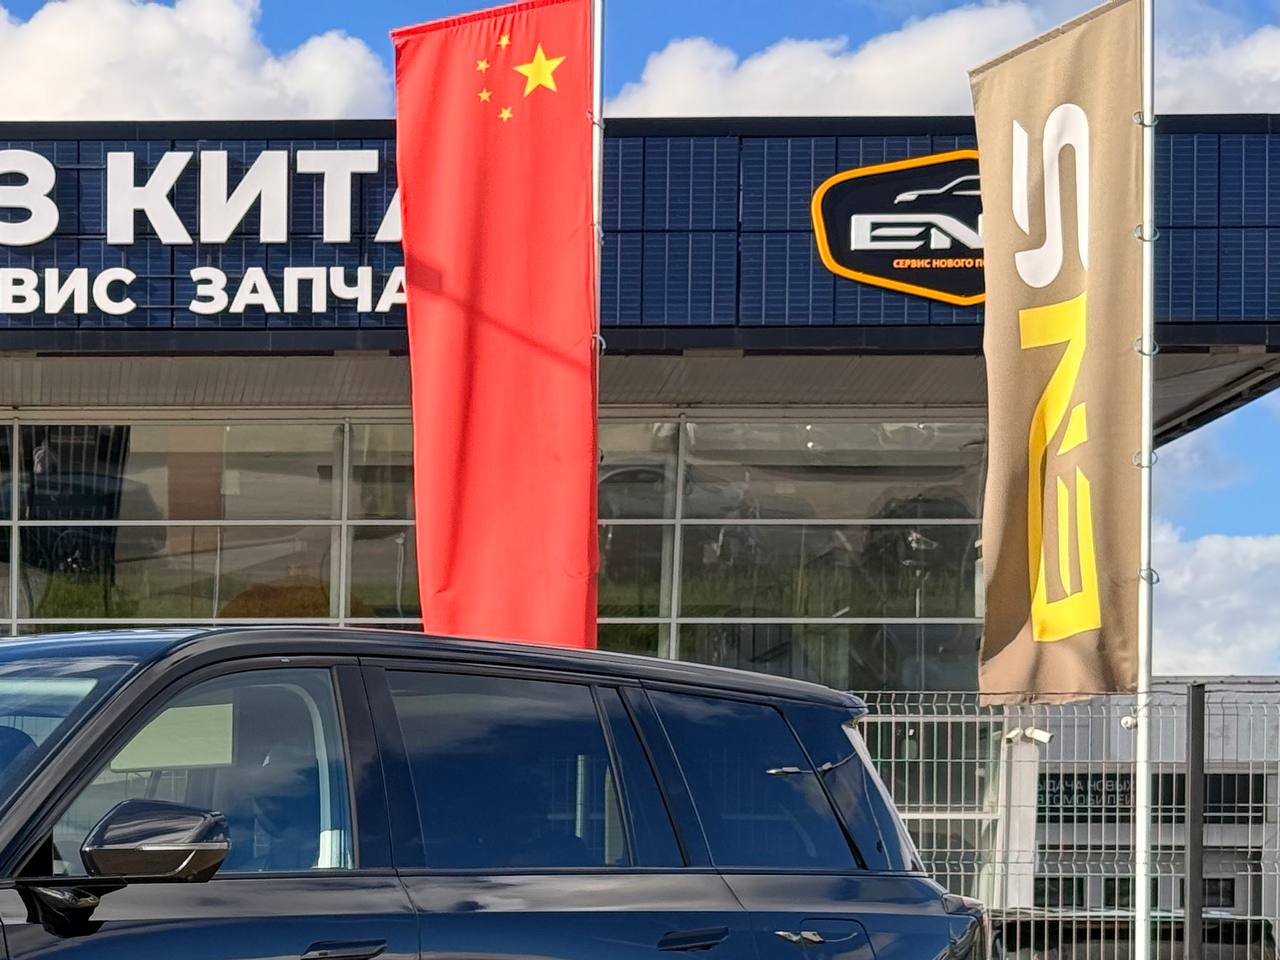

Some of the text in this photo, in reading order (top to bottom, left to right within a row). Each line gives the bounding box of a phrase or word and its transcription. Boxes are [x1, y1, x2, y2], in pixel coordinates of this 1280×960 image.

[105, 148, 404, 246] КИТ
[892, 258, 931, 269] СЕРВИС
[932, 258, 974, 269] НОВОГО
